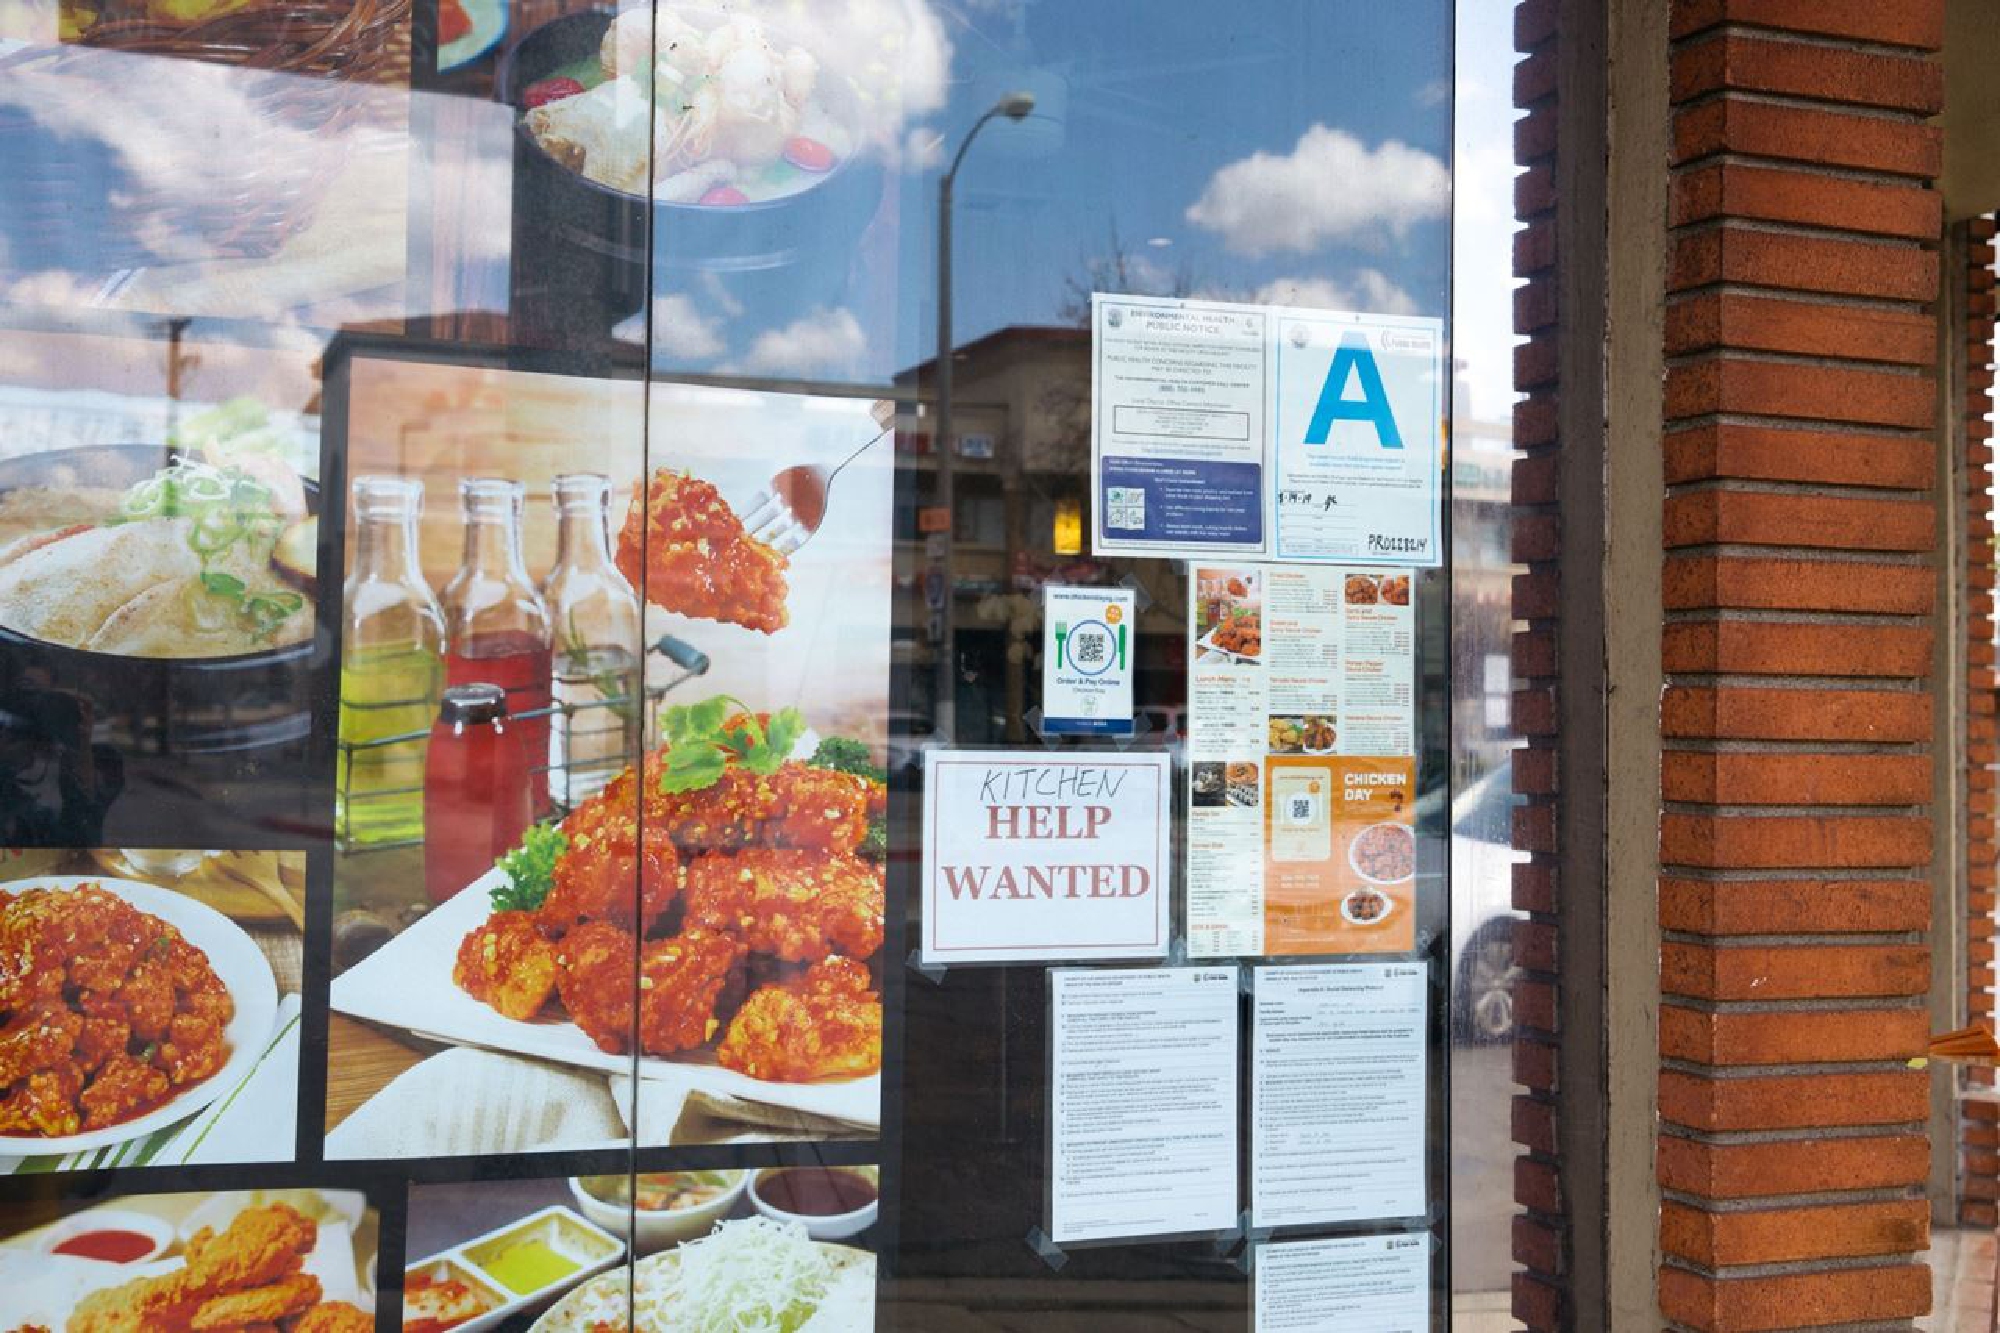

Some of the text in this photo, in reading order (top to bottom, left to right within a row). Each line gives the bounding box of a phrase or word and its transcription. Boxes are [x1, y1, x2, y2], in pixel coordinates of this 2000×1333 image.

[1146, 321, 1220, 334] PUBLIC NOTICE
[1303, 331, 1405, 449] A
[979, 766, 1129, 803] KITCHEN
[1344, 773, 1407, 787] CHICKEN
[1344, 788, 1374, 801] DAY
[984, 805, 1113, 839] HELP
[941, 864, 1151, 901] WANTED
